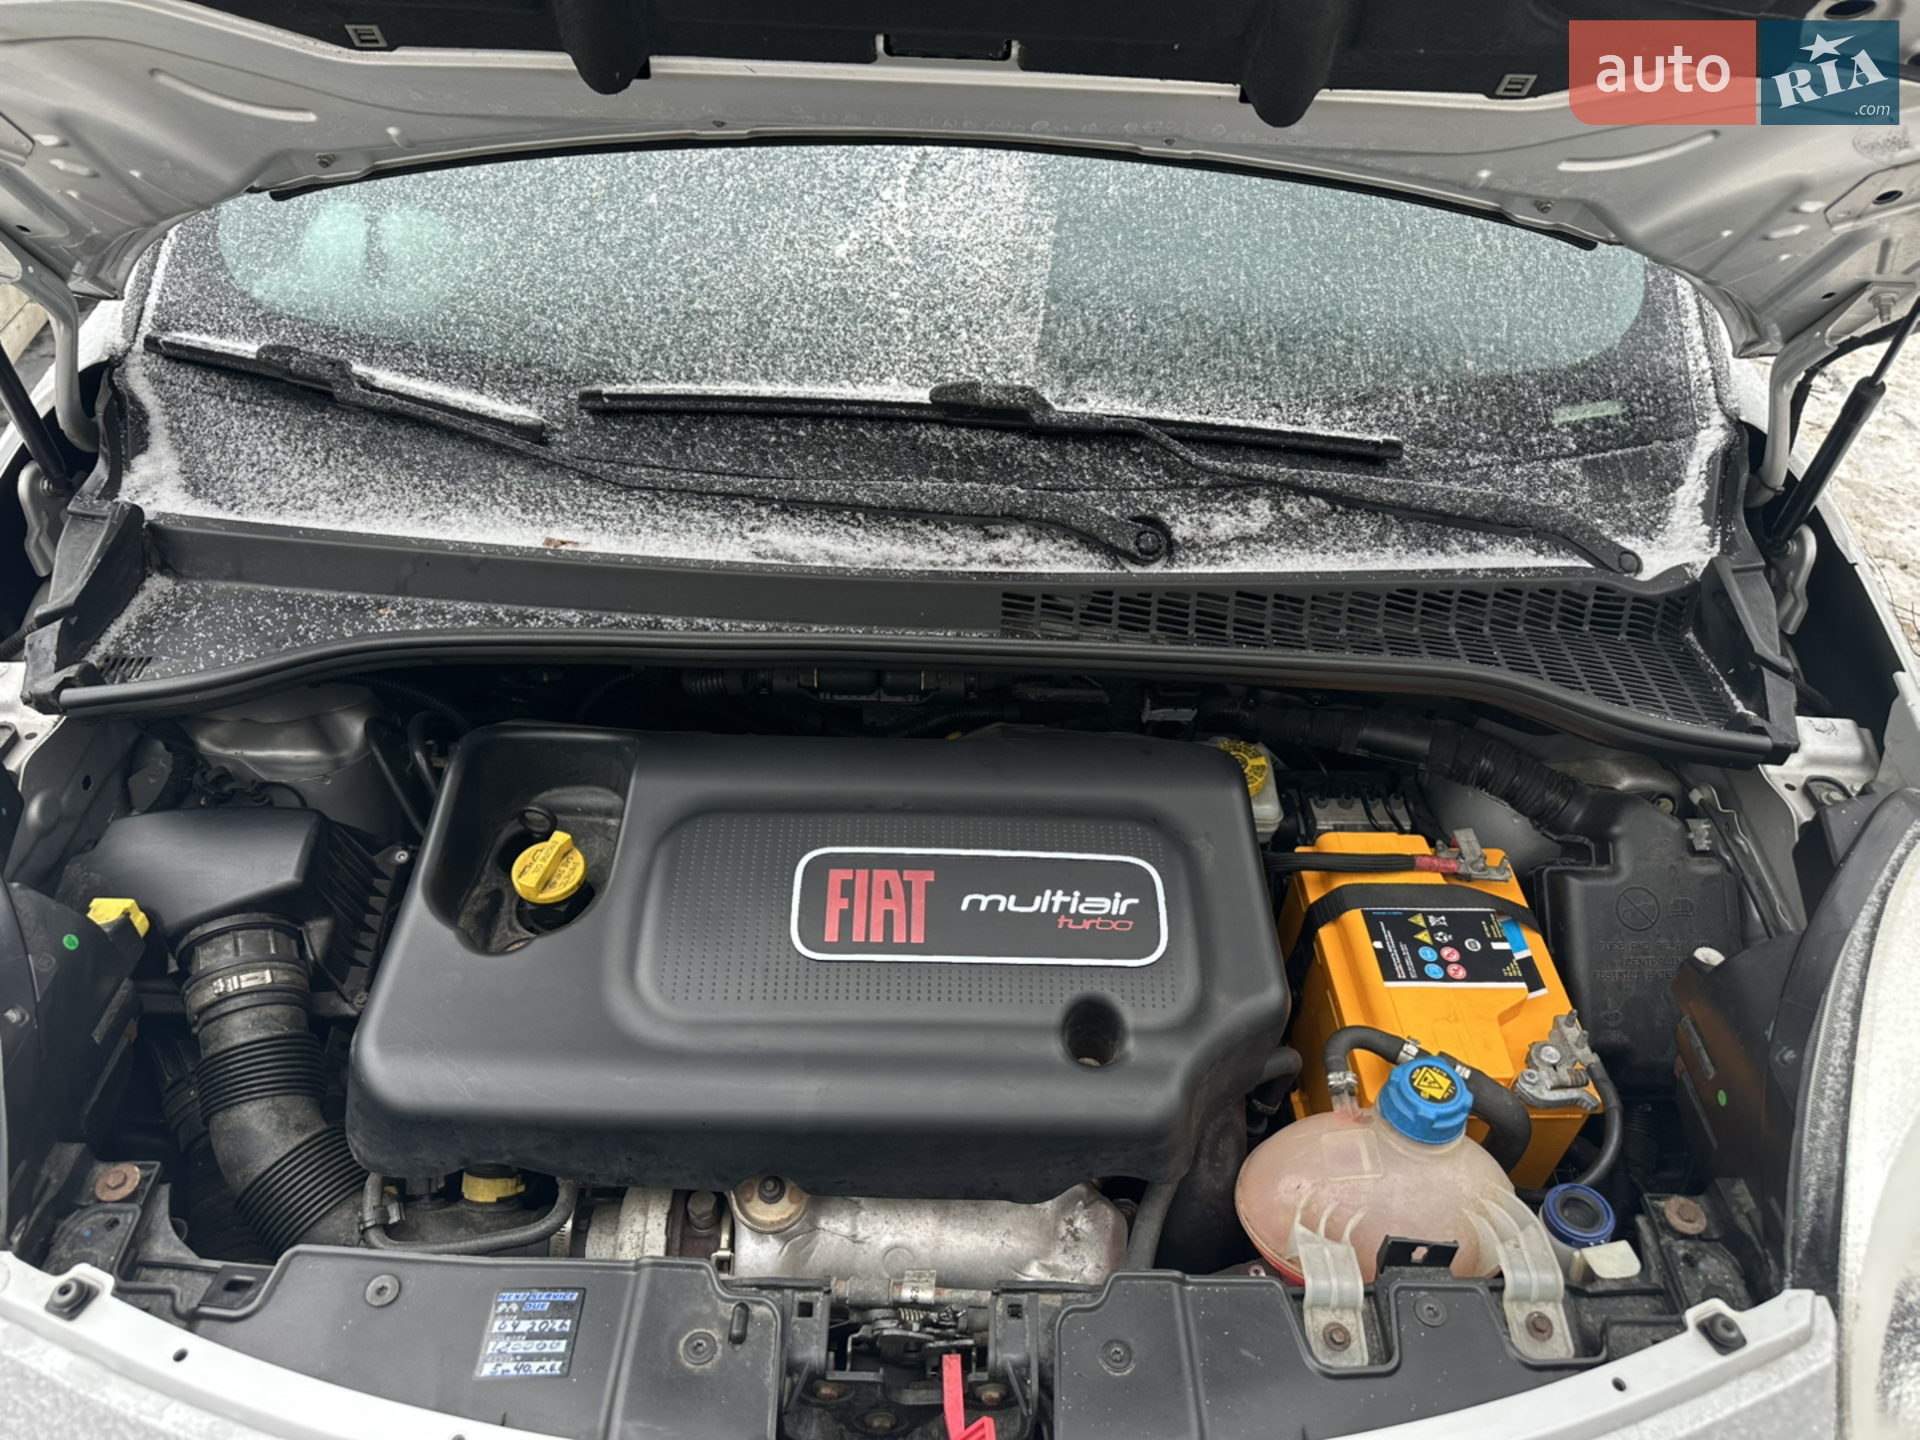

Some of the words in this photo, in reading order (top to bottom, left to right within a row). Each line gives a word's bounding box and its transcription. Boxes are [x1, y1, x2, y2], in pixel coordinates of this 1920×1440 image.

[824, 868, 935, 943] FIAT
[960, 888, 1139, 915] multiair
[1057, 915, 1134, 931] turbo
[1599, 942, 1625, 951] FUSE
[1631, 942, 1650, 951] AND
[1656, 942, 1687, 951] RELAY
[499, 1293, 529, 1301] NEXT
